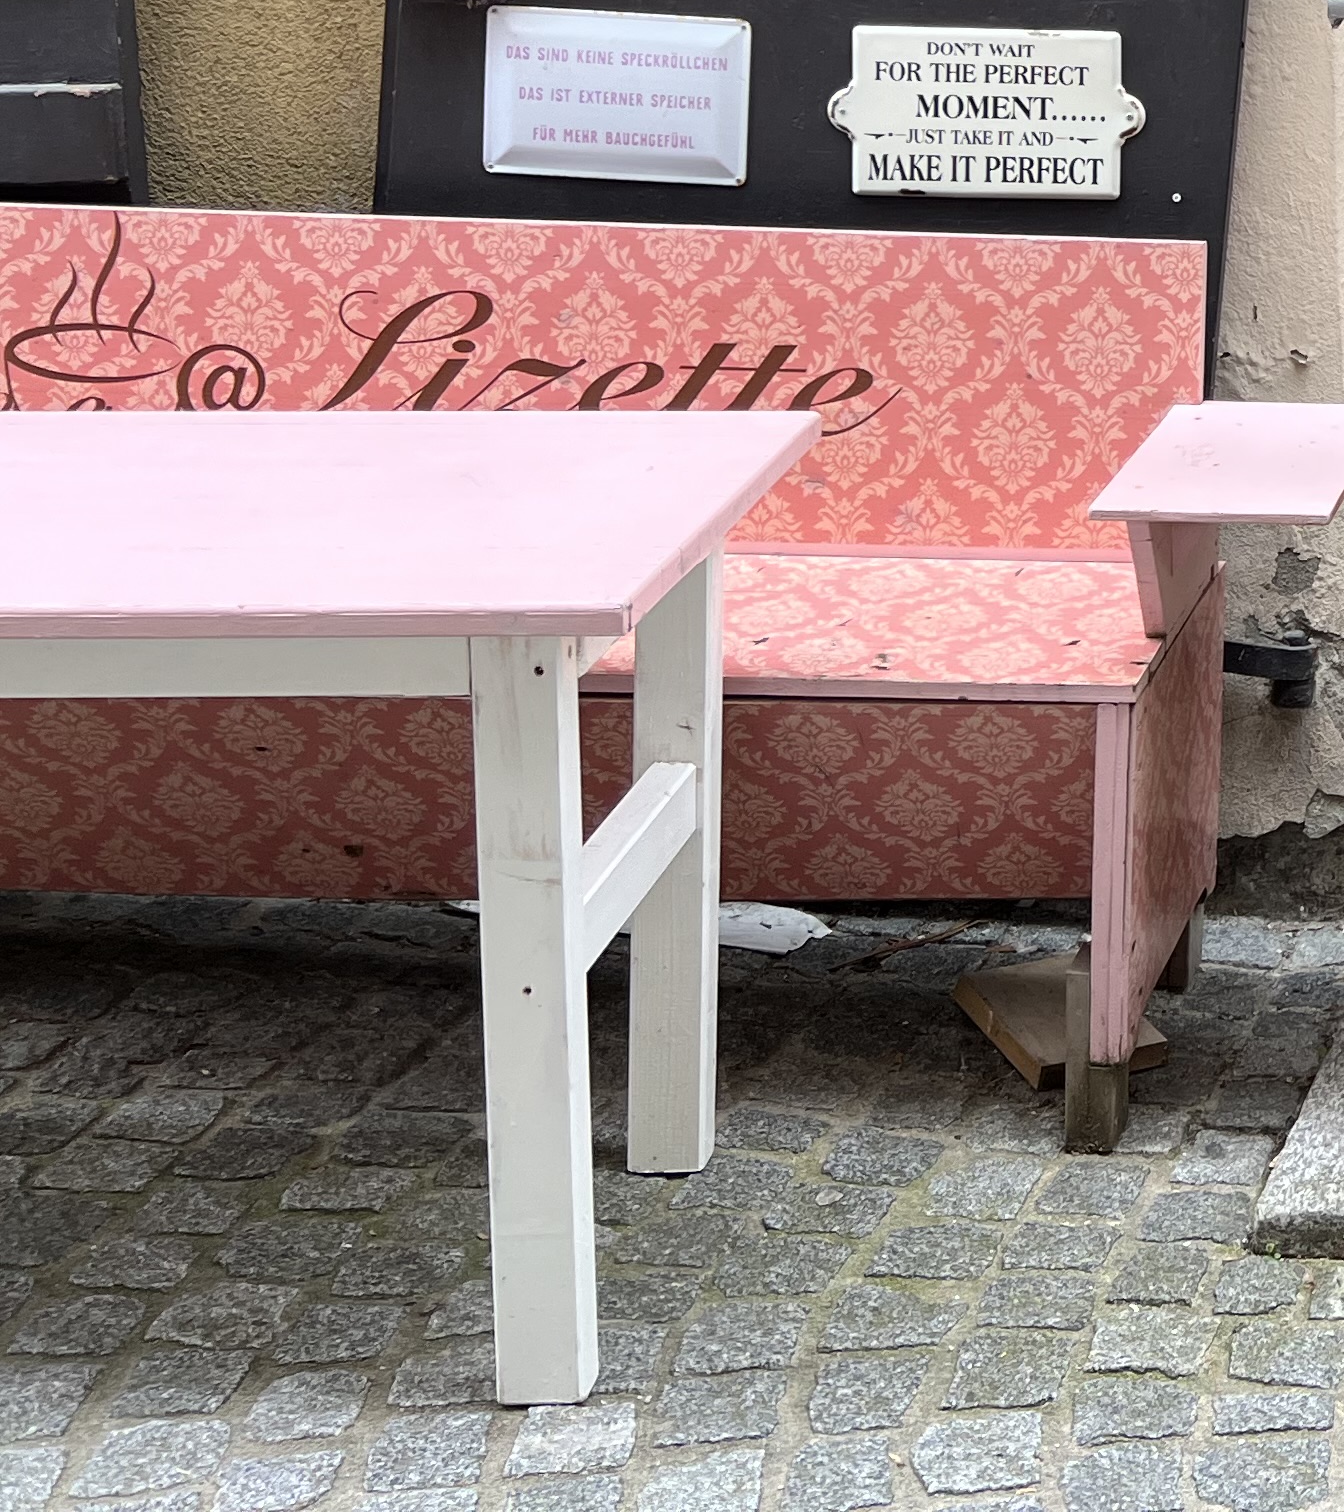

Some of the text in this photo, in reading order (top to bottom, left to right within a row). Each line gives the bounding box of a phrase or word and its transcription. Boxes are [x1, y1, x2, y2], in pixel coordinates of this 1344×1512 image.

[506, 45, 728, 72] DAS SIND KEINE SPECKRÖLLCHEN
[926, 41, 1036, 58] DON'T WAIT
[874, 61, 1089, 86] FOR THE PERFECT
[519, 86, 712, 111] DAS IST EXTERNER SPEICHER
[533, 124, 695, 150] FÜR MEHR BAUCHGEFÜHL
[905, 128, 1054, 147] JUST TAKE IT AND
[867, 153, 1104, 186] MAKE IT PERFECT
[316, 289, 903, 438] Lizette
